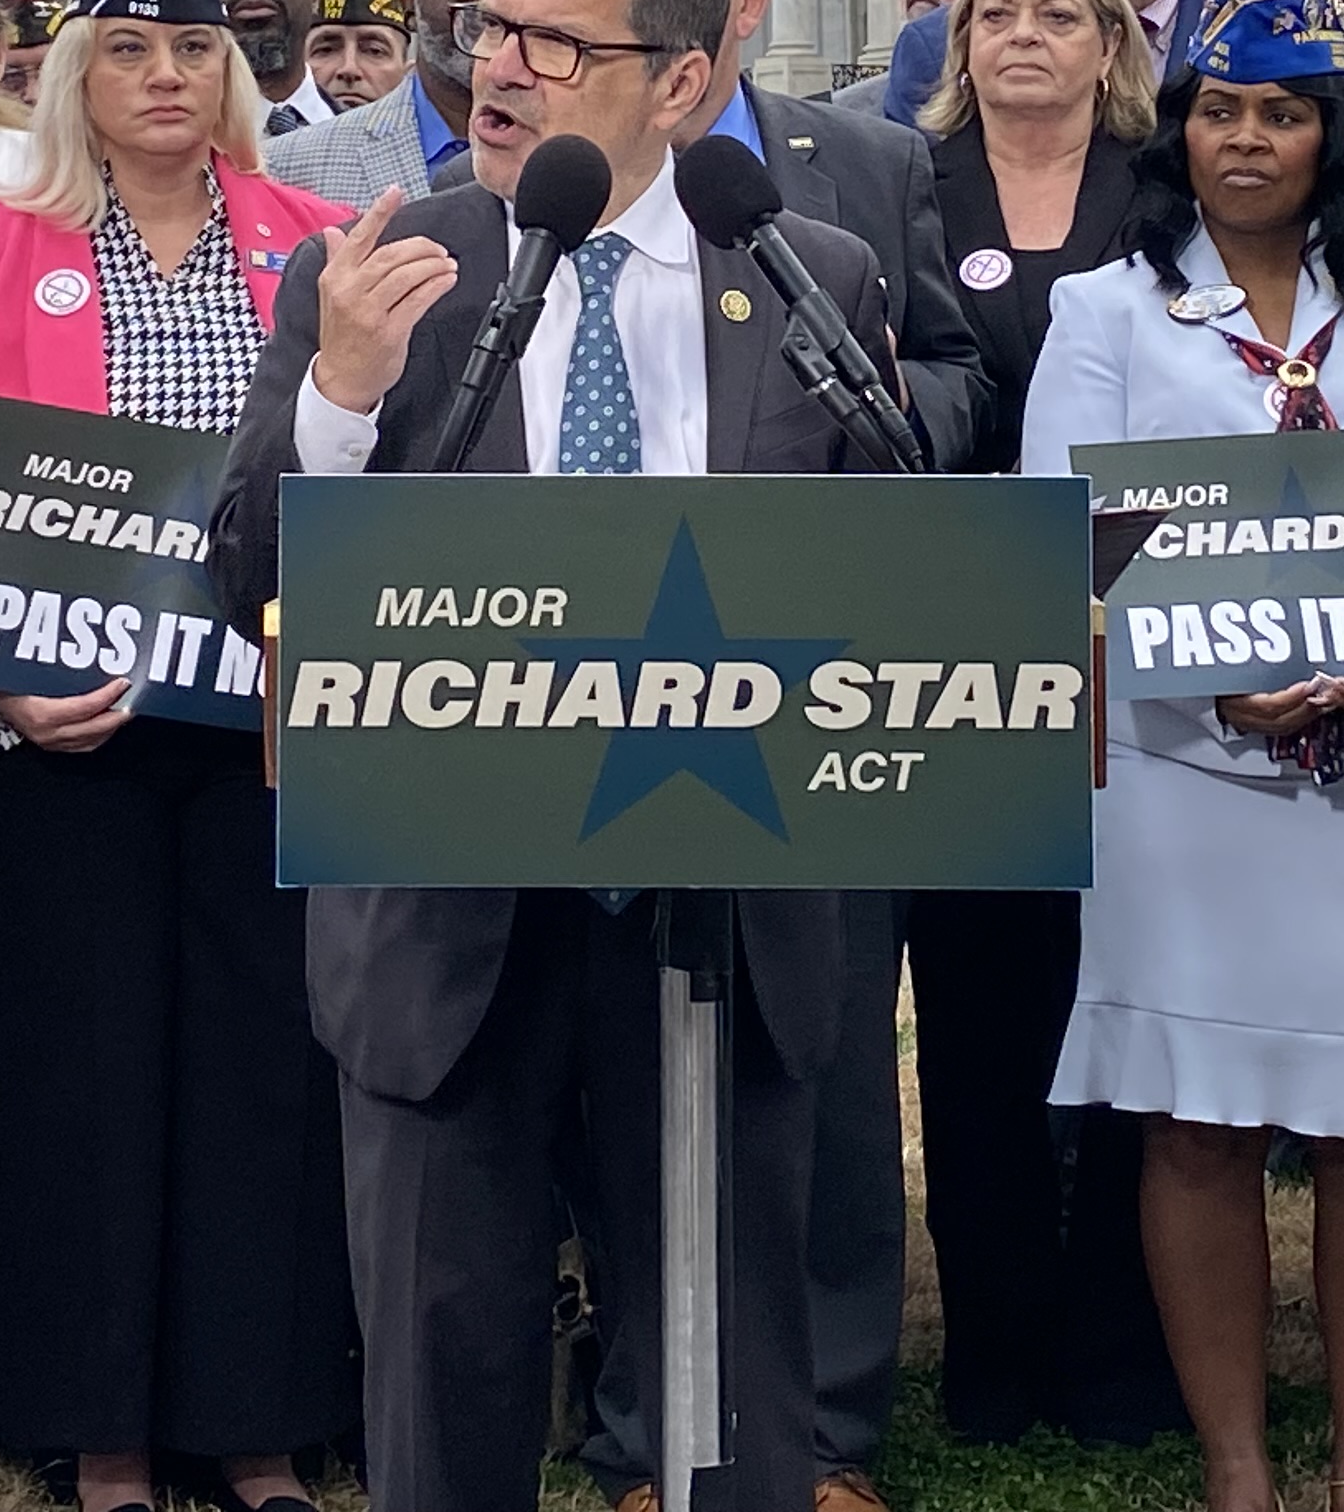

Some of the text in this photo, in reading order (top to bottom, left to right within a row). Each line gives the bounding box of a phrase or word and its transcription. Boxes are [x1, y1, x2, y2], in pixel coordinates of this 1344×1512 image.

[23, 453, 135, 493] MAJOR
[1122, 483, 1230, 510] MAJOR
[374, 586, 569, 628] MAJOR
[147, 611, 214, 688] IT
[1126, 598, 1292, 670] PASS
[287, 659, 784, 729] RICHARD
[804, 661, 1085, 731] STAR
[806, 751, 925, 792] ACT
